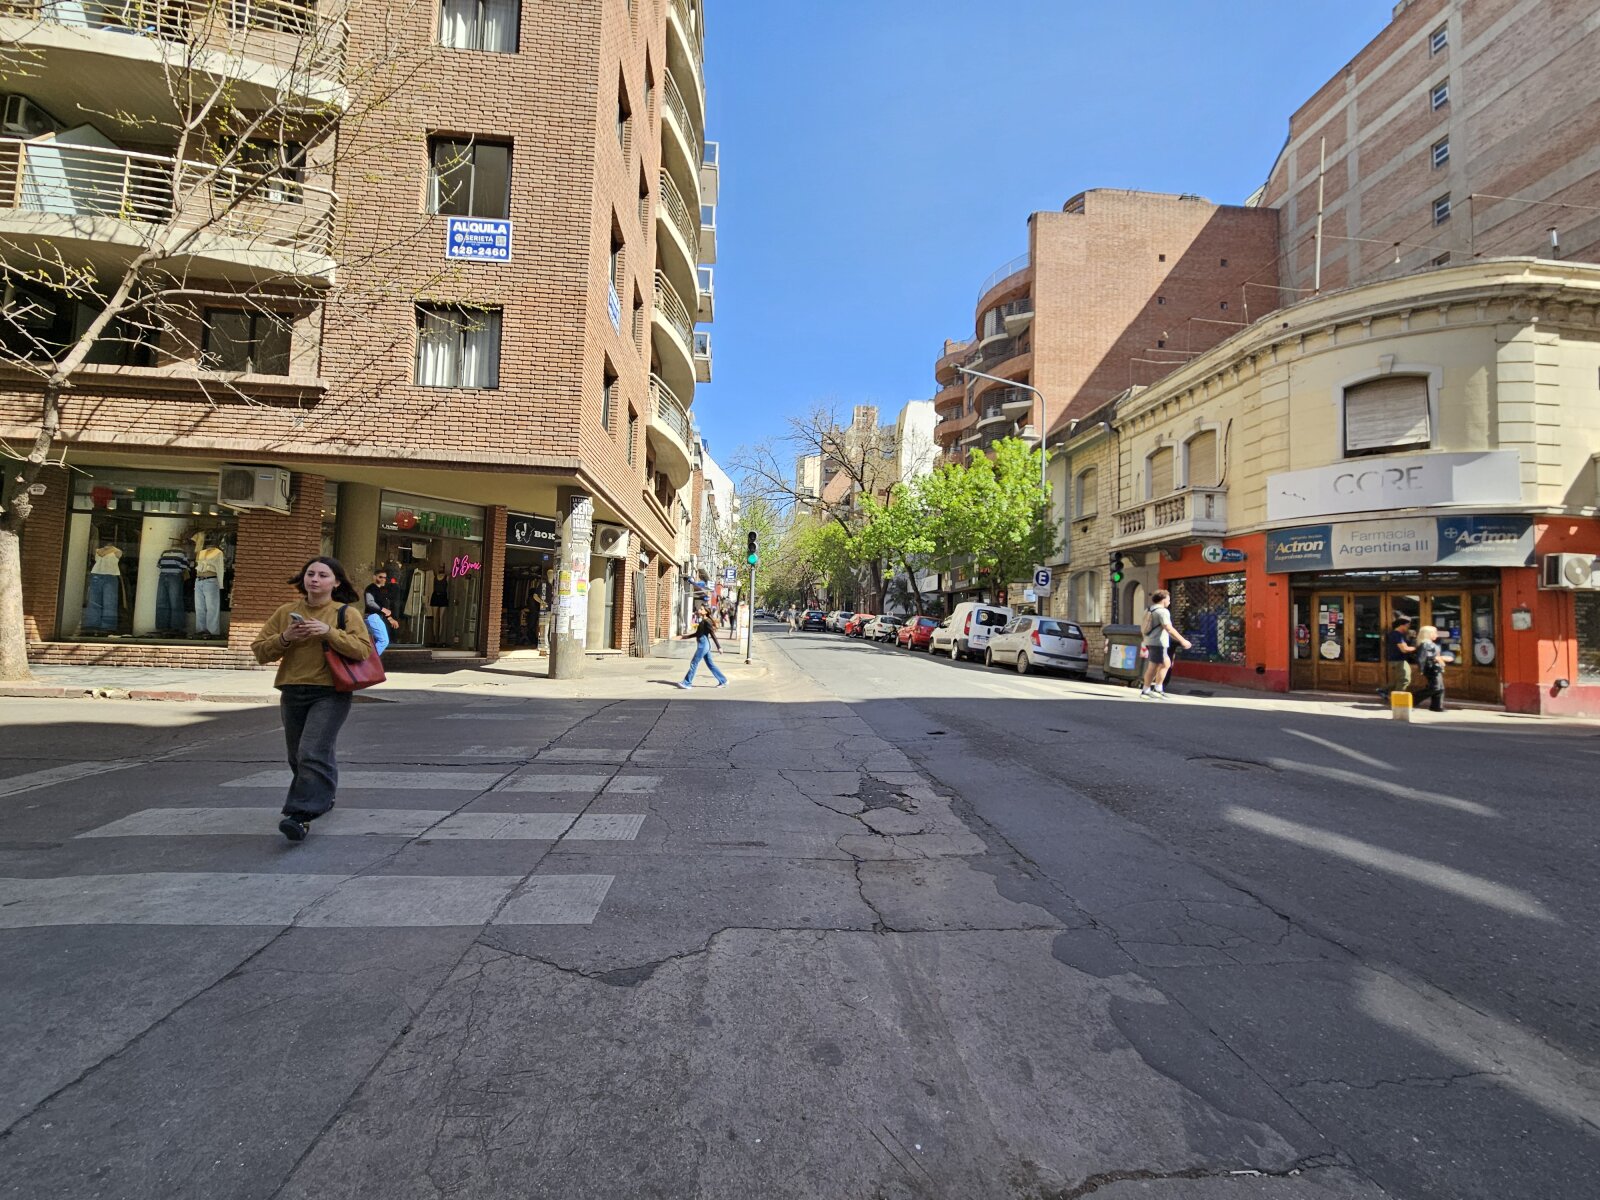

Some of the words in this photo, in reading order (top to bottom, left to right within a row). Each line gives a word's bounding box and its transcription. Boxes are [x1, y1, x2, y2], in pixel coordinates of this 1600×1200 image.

[453, 221, 507, 235] ALQUILA
[452, 246, 507, 257] 428-2460
[1351, 528, 1416, 541] Farmacia
[1455, 530, 1518, 544] Actron
[1274, 540, 1324, 554] Actron
[1339, 541, 1411, 557] Argentina
[1415, 540, 1429, 551] III
[727, 569, 735, 579] E
[1039, 570, 1048, 585] E
